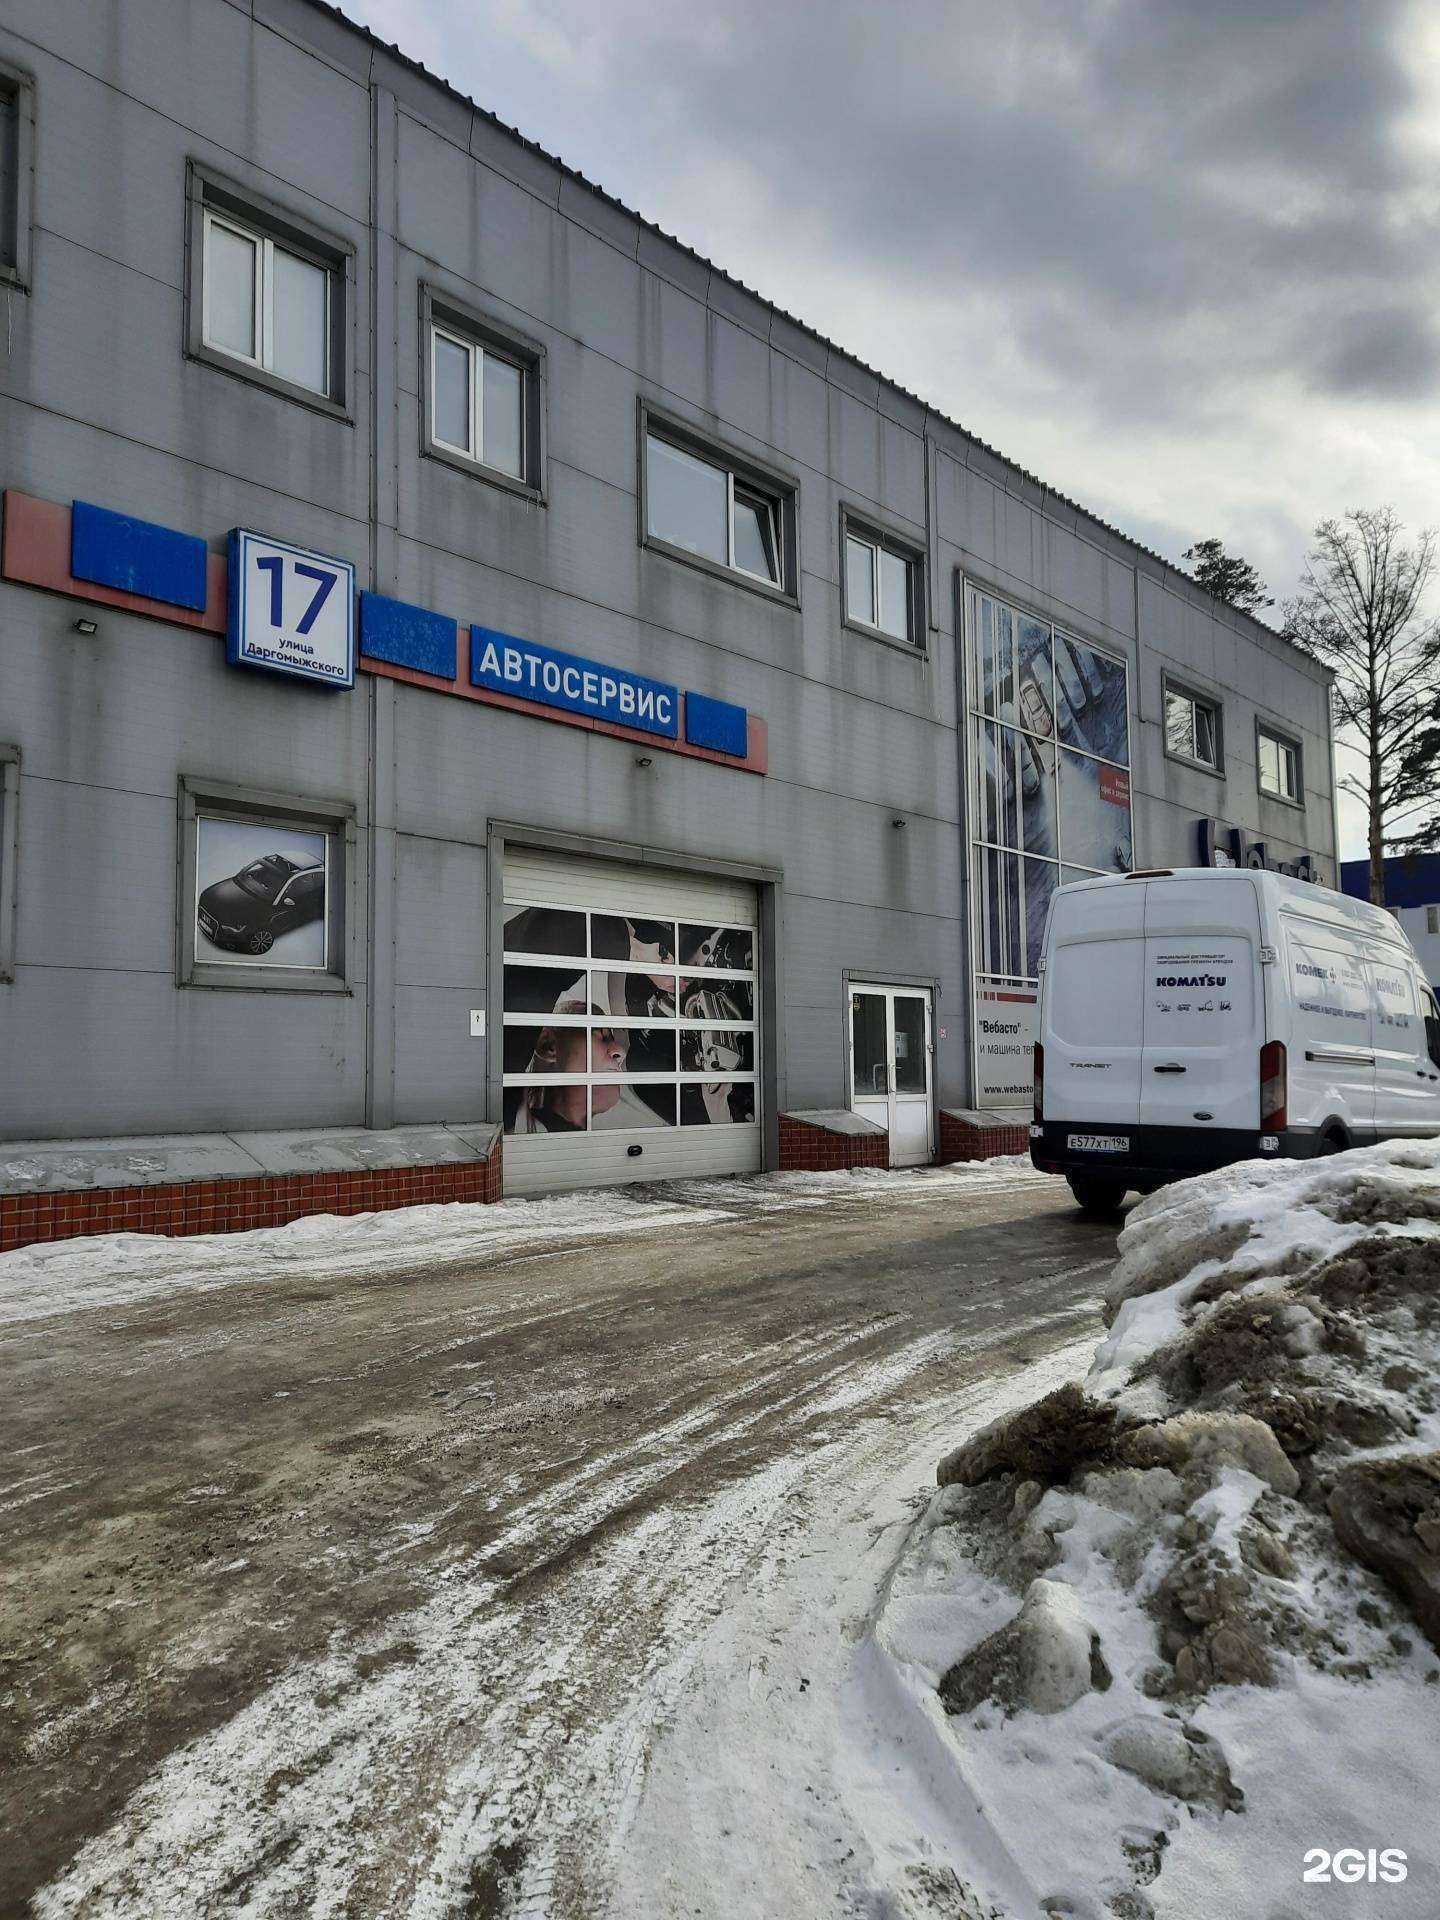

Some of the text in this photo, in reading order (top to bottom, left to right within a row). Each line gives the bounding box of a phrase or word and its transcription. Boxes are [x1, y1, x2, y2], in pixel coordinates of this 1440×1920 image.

[256, 556, 338, 635] 17
[278, 638, 315, 655] улица
[246, 642, 345, 676] Даргомыжского
[479, 642, 672, 724] АВТОСЕРВИС
[1155, 973, 1227, 987] KOMATSU
[979, 1020, 1021, 1034] "Вебасто"
[979, 1045, 986, 1055] и
[987, 1044, 1021, 1055] машина
